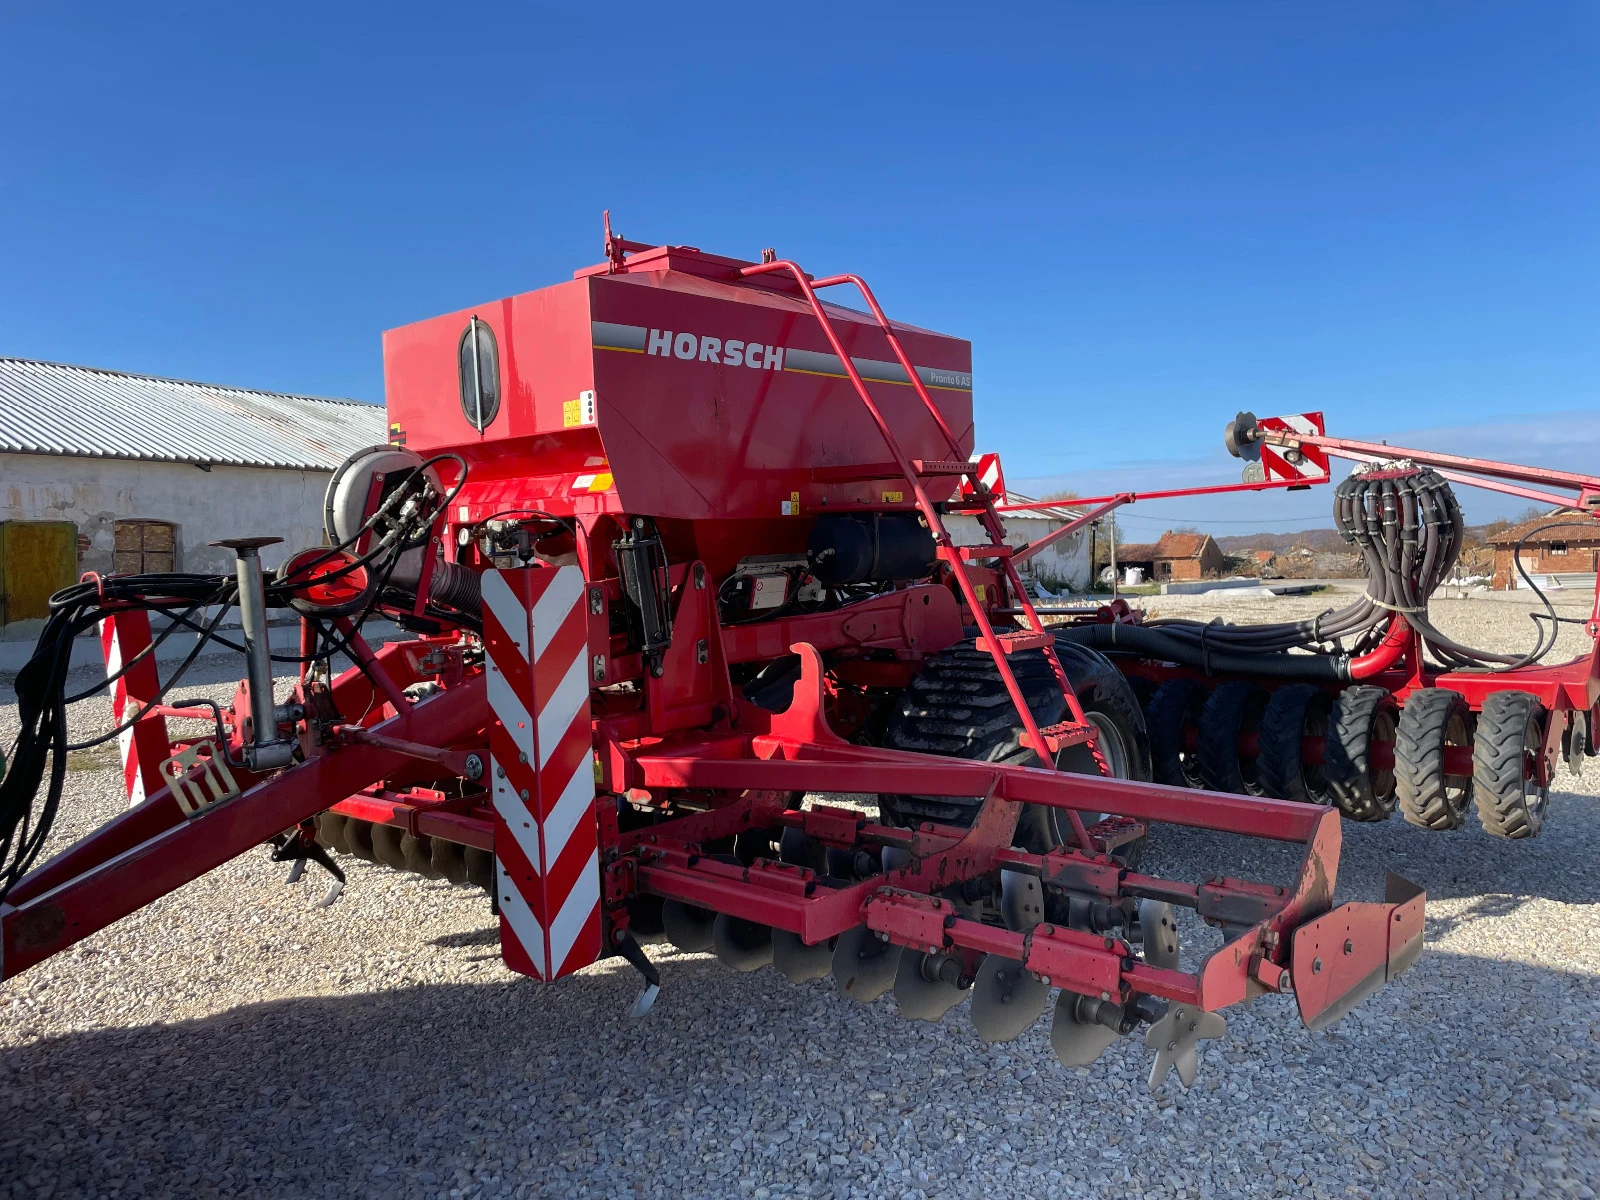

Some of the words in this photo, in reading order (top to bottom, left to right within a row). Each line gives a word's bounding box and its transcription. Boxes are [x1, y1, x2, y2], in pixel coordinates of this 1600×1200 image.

[648, 329, 784, 371] HORSCH
[930, 372, 955, 385] Pronto
[955, 375, 960, 385] 6
[961, 376, 971, 387] AS
